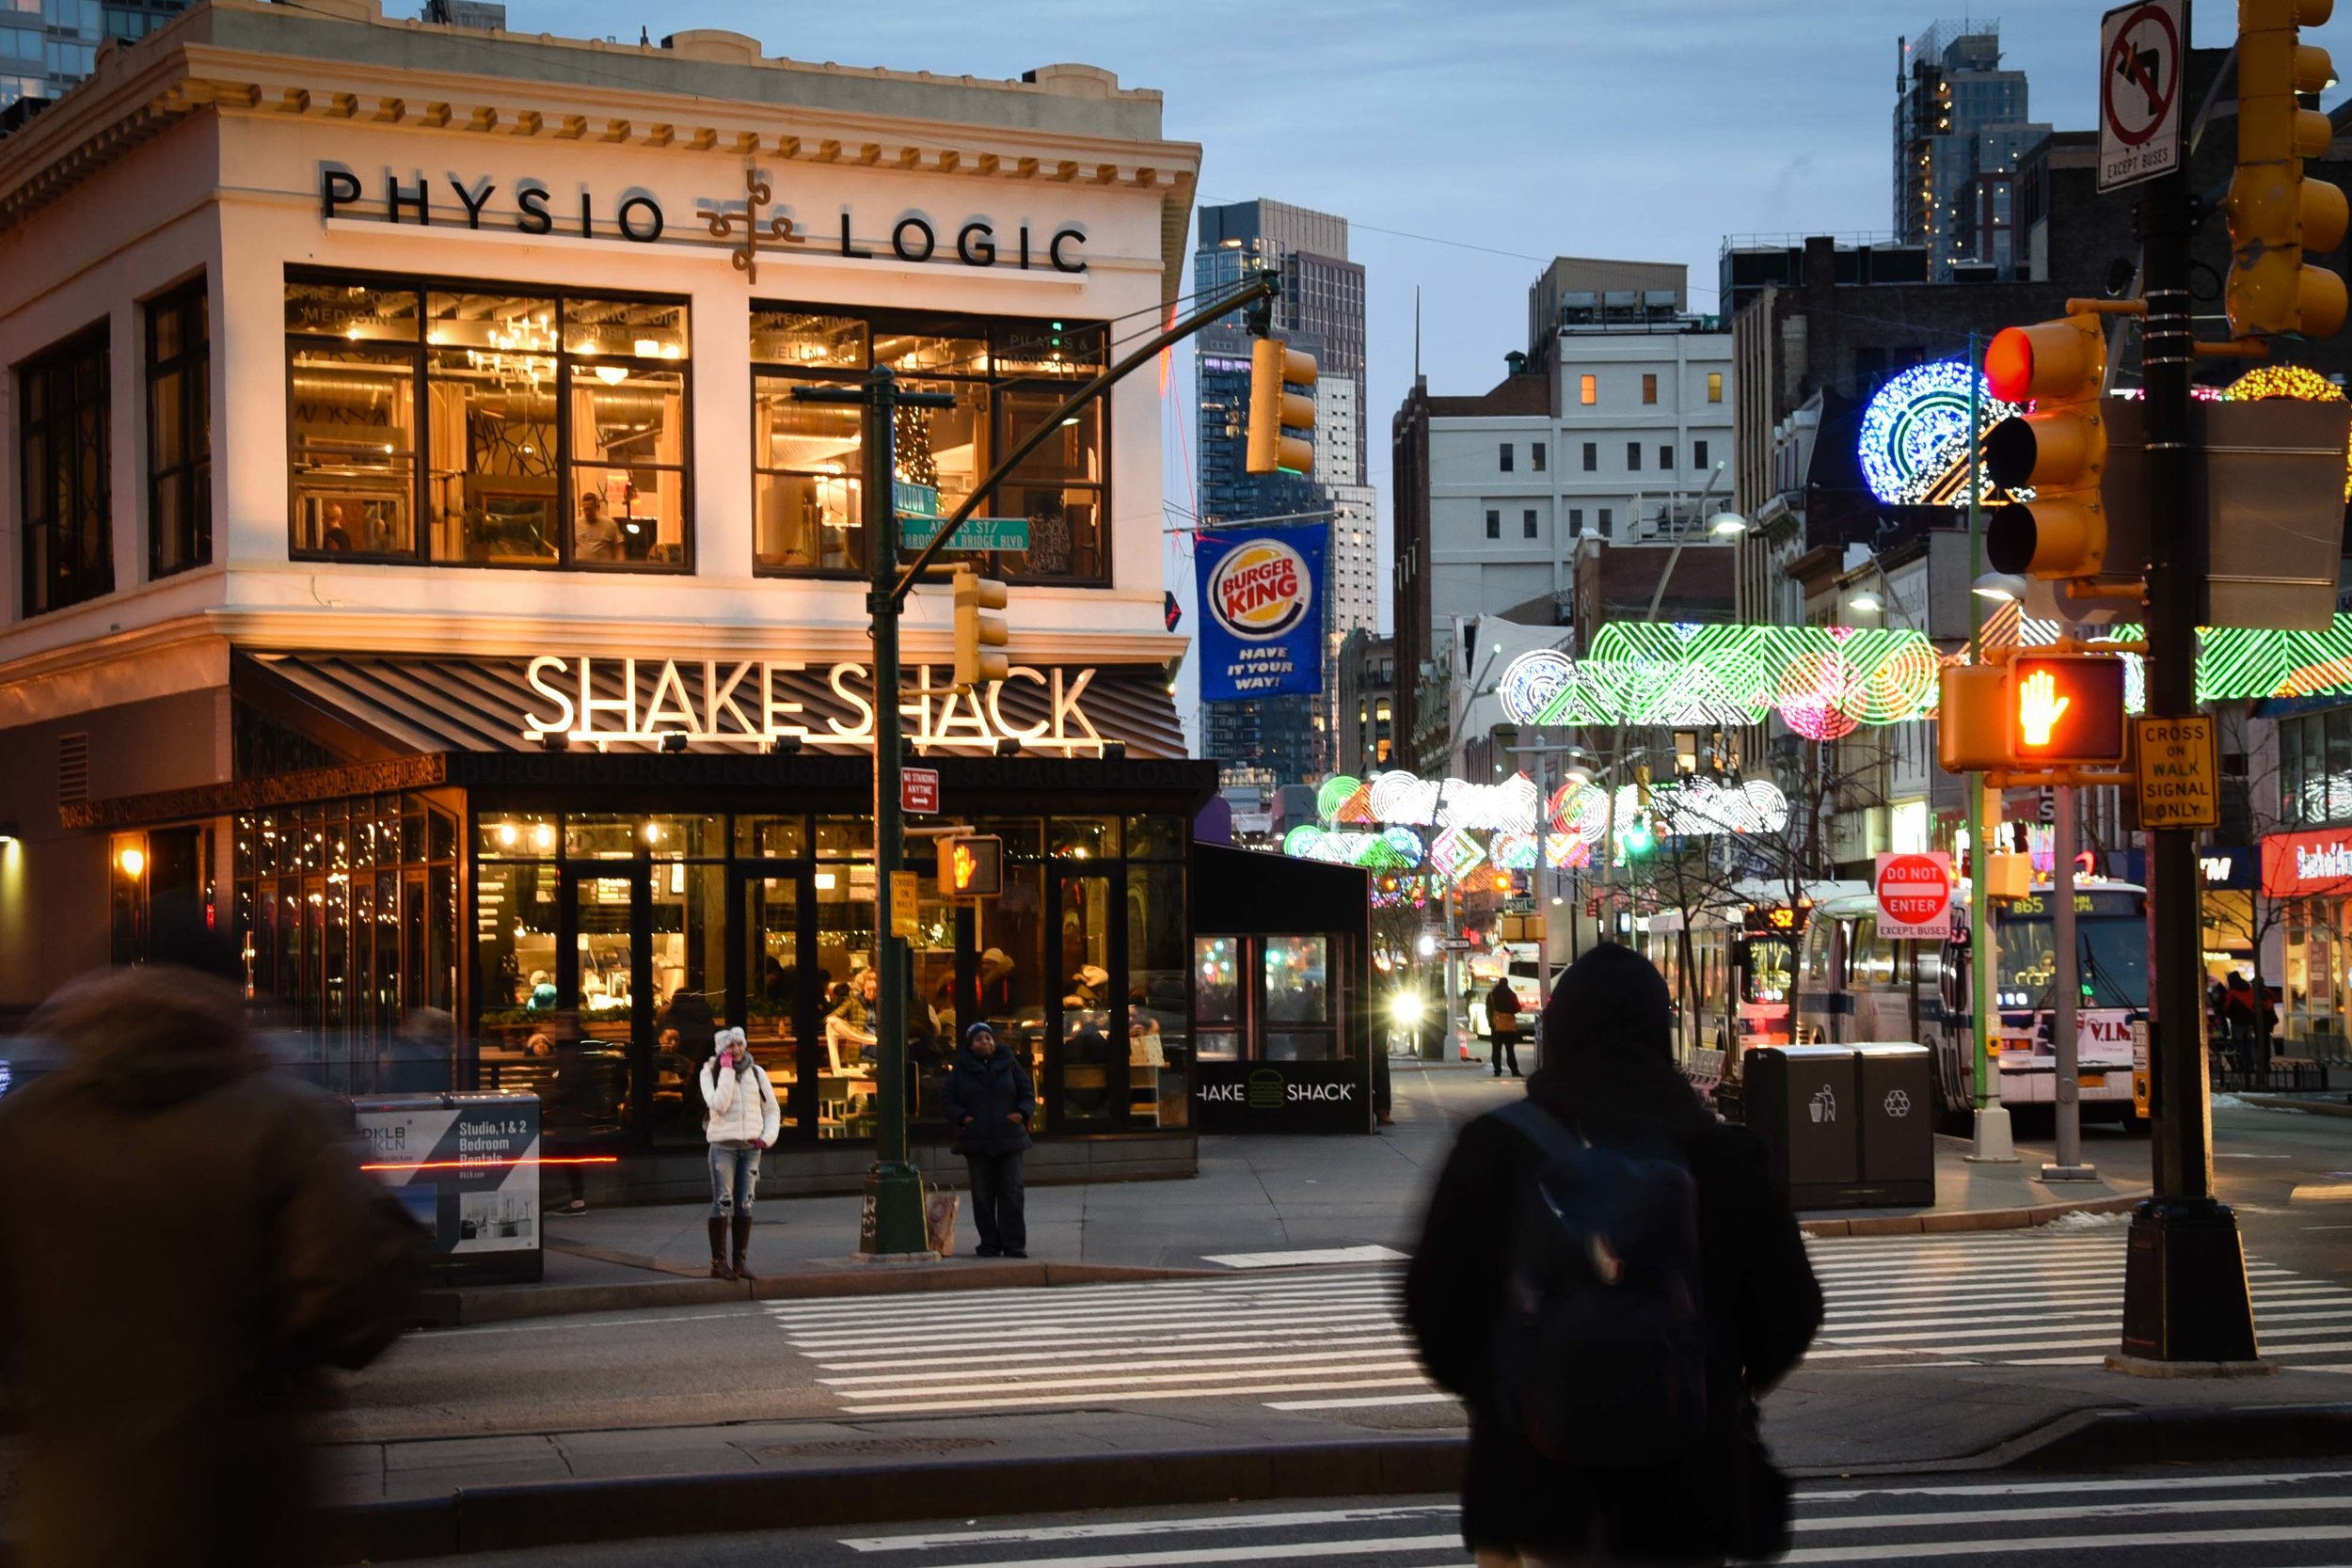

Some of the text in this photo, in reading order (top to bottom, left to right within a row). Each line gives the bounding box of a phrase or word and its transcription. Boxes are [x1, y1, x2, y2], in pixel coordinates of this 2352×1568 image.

[2107, 148, 2169, 179] EXCEPT BUSES
[325, 170, 1088, 273] PHYSIO LOGIC
[1009, 333, 1073, 351] PILATS
[897, 485, 924, 513] ULTON
[906, 533, 1023, 548] BROON BRIDGE BLVD
[1223, 558, 1295, 596] BURGER
[1227, 574, 1298, 621] KING
[1239, 647, 1288, 660] HAVE
[1227, 661, 1293, 676] IT YOUR
[1235, 676, 1280, 690] WAY!
[523, 656, 1100, 741] SHAKE SHACK
[2146, 725, 2204, 742] CROSS
[2167, 746, 2185, 756] ON
[754, 756, 873, 784] CUSTAR
[903, 771, 912, 783] NO
[2153, 762, 2199, 777] WALK
[2146, 782, 2209, 798] SIGNAL
[2156, 803, 2200, 818] ONLY
[1886, 866, 1939, 880] DO NOT
[1890, 899, 1937, 912] ENTER
[1880, 926, 1947, 935] EXCEPT BUSES
[1196, 1083, 1352, 1101] HAKE SHACK
[508, 1120, 516, 1134] &
[519, 1119, 527, 1133] 2
[459, 1136, 509, 1152] Bedroom
[459, 1151, 502, 1168] Rentals
